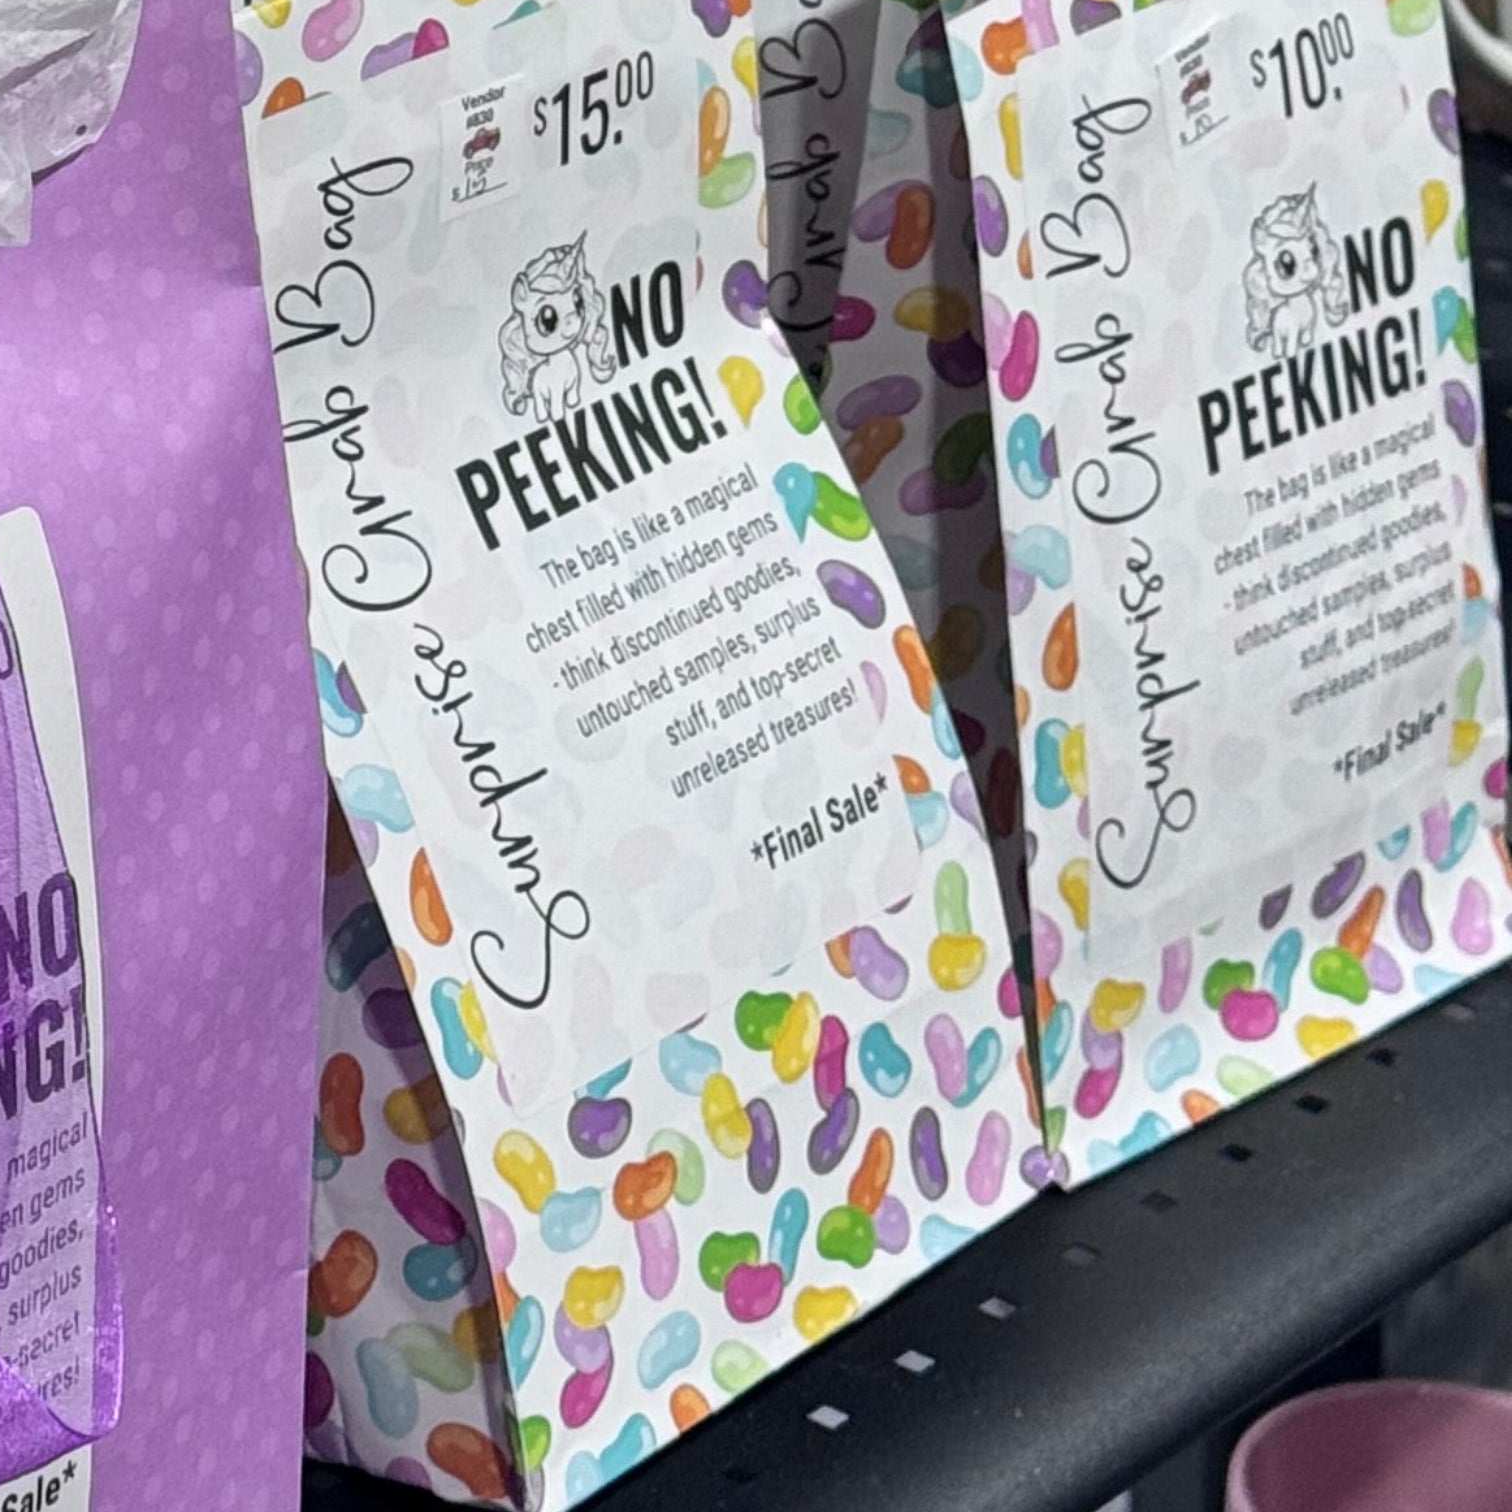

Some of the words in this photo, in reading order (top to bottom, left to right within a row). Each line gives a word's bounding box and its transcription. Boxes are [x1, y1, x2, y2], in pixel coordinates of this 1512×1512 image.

[1040, 94, 1152, 279] Bag
[273, 156, 413, 354] Bag
[611, 261, 684, 368] NO
[1344, 216, 1415, 315] NO
[455, 356, 728, 550] PEEKING!
[1056, 313, 1162, 524] Grab
[1198, 308, 1427, 475] PEEKING!
[282, 384, 432, 613] Grab
[540, 557, 577, 589] The
[577, 537, 620, 573] bag
[613, 527, 637, 551] is
[632, 514, 671, 545] like
[670, 504, 685, 526] a
[685, 461, 759, 520] magical
[1215, 536, 1261, 575] chest
[1244, 486, 1275, 516] The
[1278, 473, 1309, 502] bag
[525, 608, 579, 654] chest
[577, 583, 625, 627] filled
[624, 564, 667, 602] with
[664, 536, 728, 583] hidden
[726, 512, 778, 557] gems
[560, 648, 611, 690] think
[610, 586, 724, 665] discontinued
[724, 556, 801, 613] goodies,
[577, 667, 674, 738] untouched
[674, 633, 758, 686] samples,
[755, 596, 821, 646] surplus
[666, 700, 718, 747] stuff,
[716, 681, 752, 720] and
[752, 636, 842, 699] top-secret
[1095, 537, 1201, 888] Surprise
[671, 724, 770, 799] unreleased
[769, 677, 858, 745] treasures!
[414, 624, 590, 1009] Surprise
[7, 1111, 88, 1187] magical
[30, 1168, 85, 1224] gems
[8, 1265, 81, 1326] surplus
